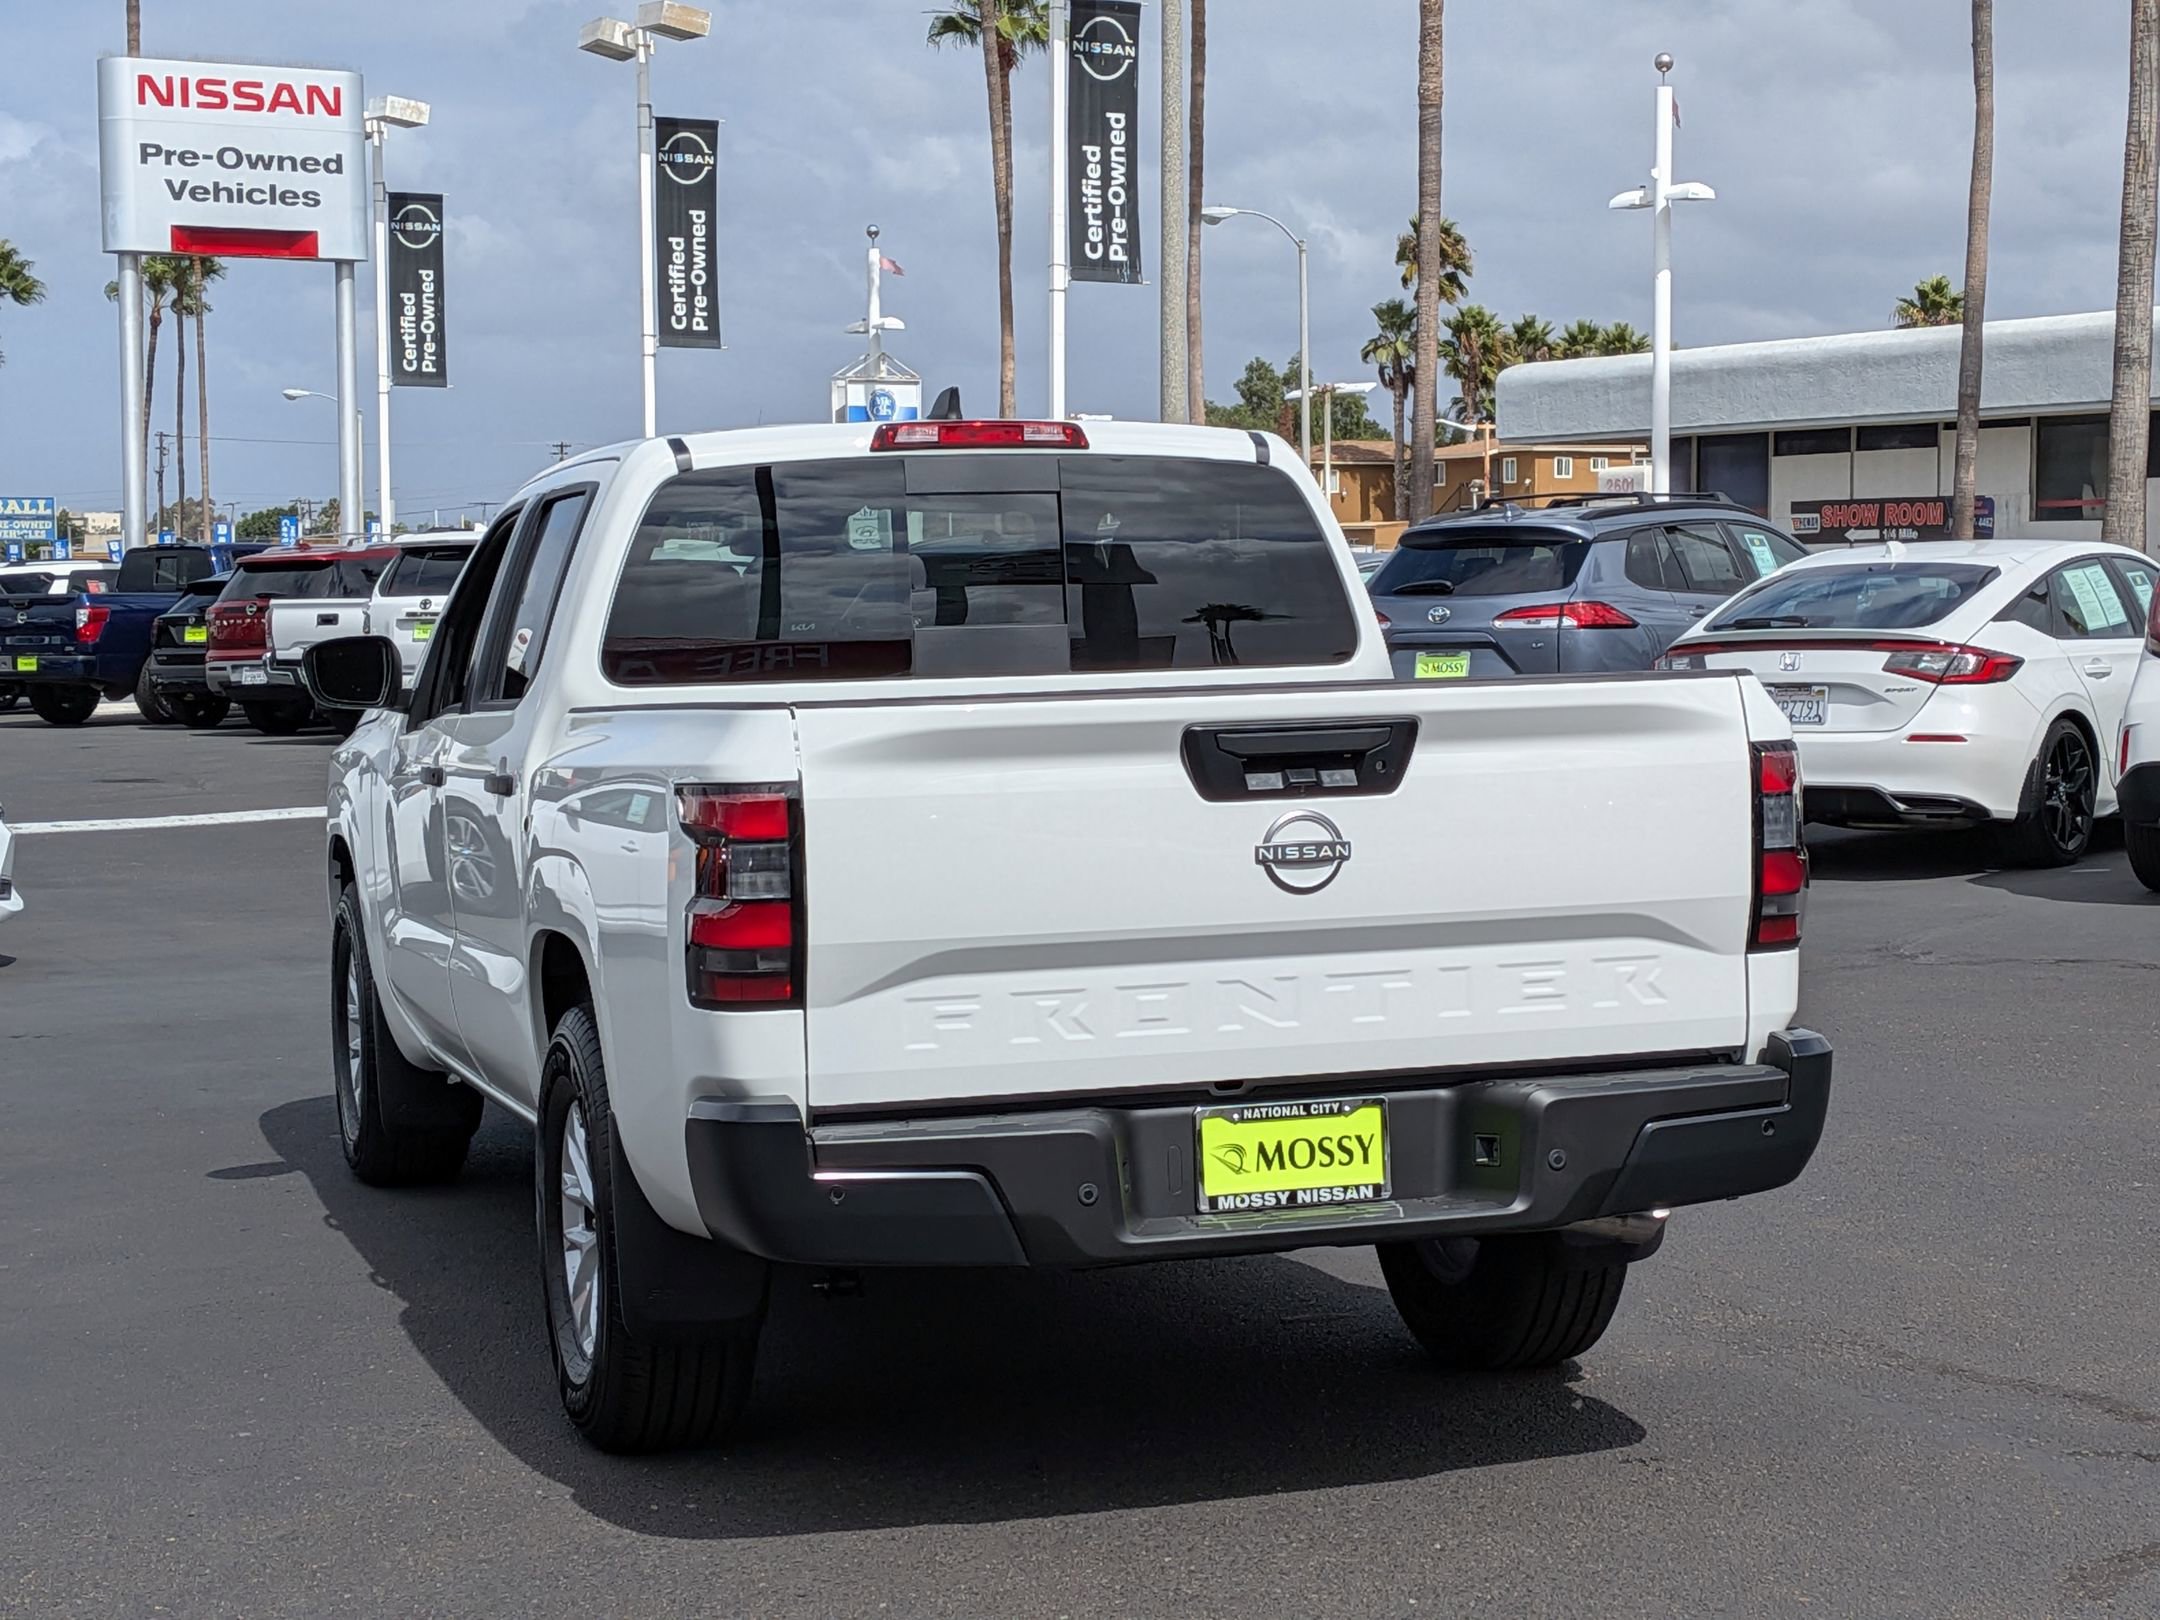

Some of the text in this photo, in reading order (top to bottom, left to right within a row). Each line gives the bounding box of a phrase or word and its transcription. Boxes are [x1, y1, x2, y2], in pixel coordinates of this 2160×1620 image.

[1073, 40, 1135, 57] NISSAN
[137, 74, 342, 116] NISSAN
[139, 142, 344, 174] Pre-Owned
[658, 152, 715, 165] NISSAN
[164, 178, 322, 208] Vehicles
[1106, 112, 1128, 262] Pre-Owned
[1081, 146, 1104, 260] Certified
[391, 221, 441, 232] NISSAN
[668, 237, 687, 330] Certified
[688, 210, 708, 331] Pre-Owned
[400, 293, 418, 372] Certified
[418, 269, 436, 372] Pre-Owned
[1606, 478, 1634, 493] 2601
[1821, 503, 1880, 528] SHOW
[1884, 502, 1944, 526] ROOM
[1432, 661, 1465, 674] MOSSY
[1257, 843, 1350, 862] NISSAN
[903, 953, 1670, 1050] FRONTIER
[1243, 1102, 1340, 1120] NATIONAL CITY
[1256, 1133, 1375, 1172] MOSSY
[1217, 1185, 1375, 1210] MOSSY NISSAN
